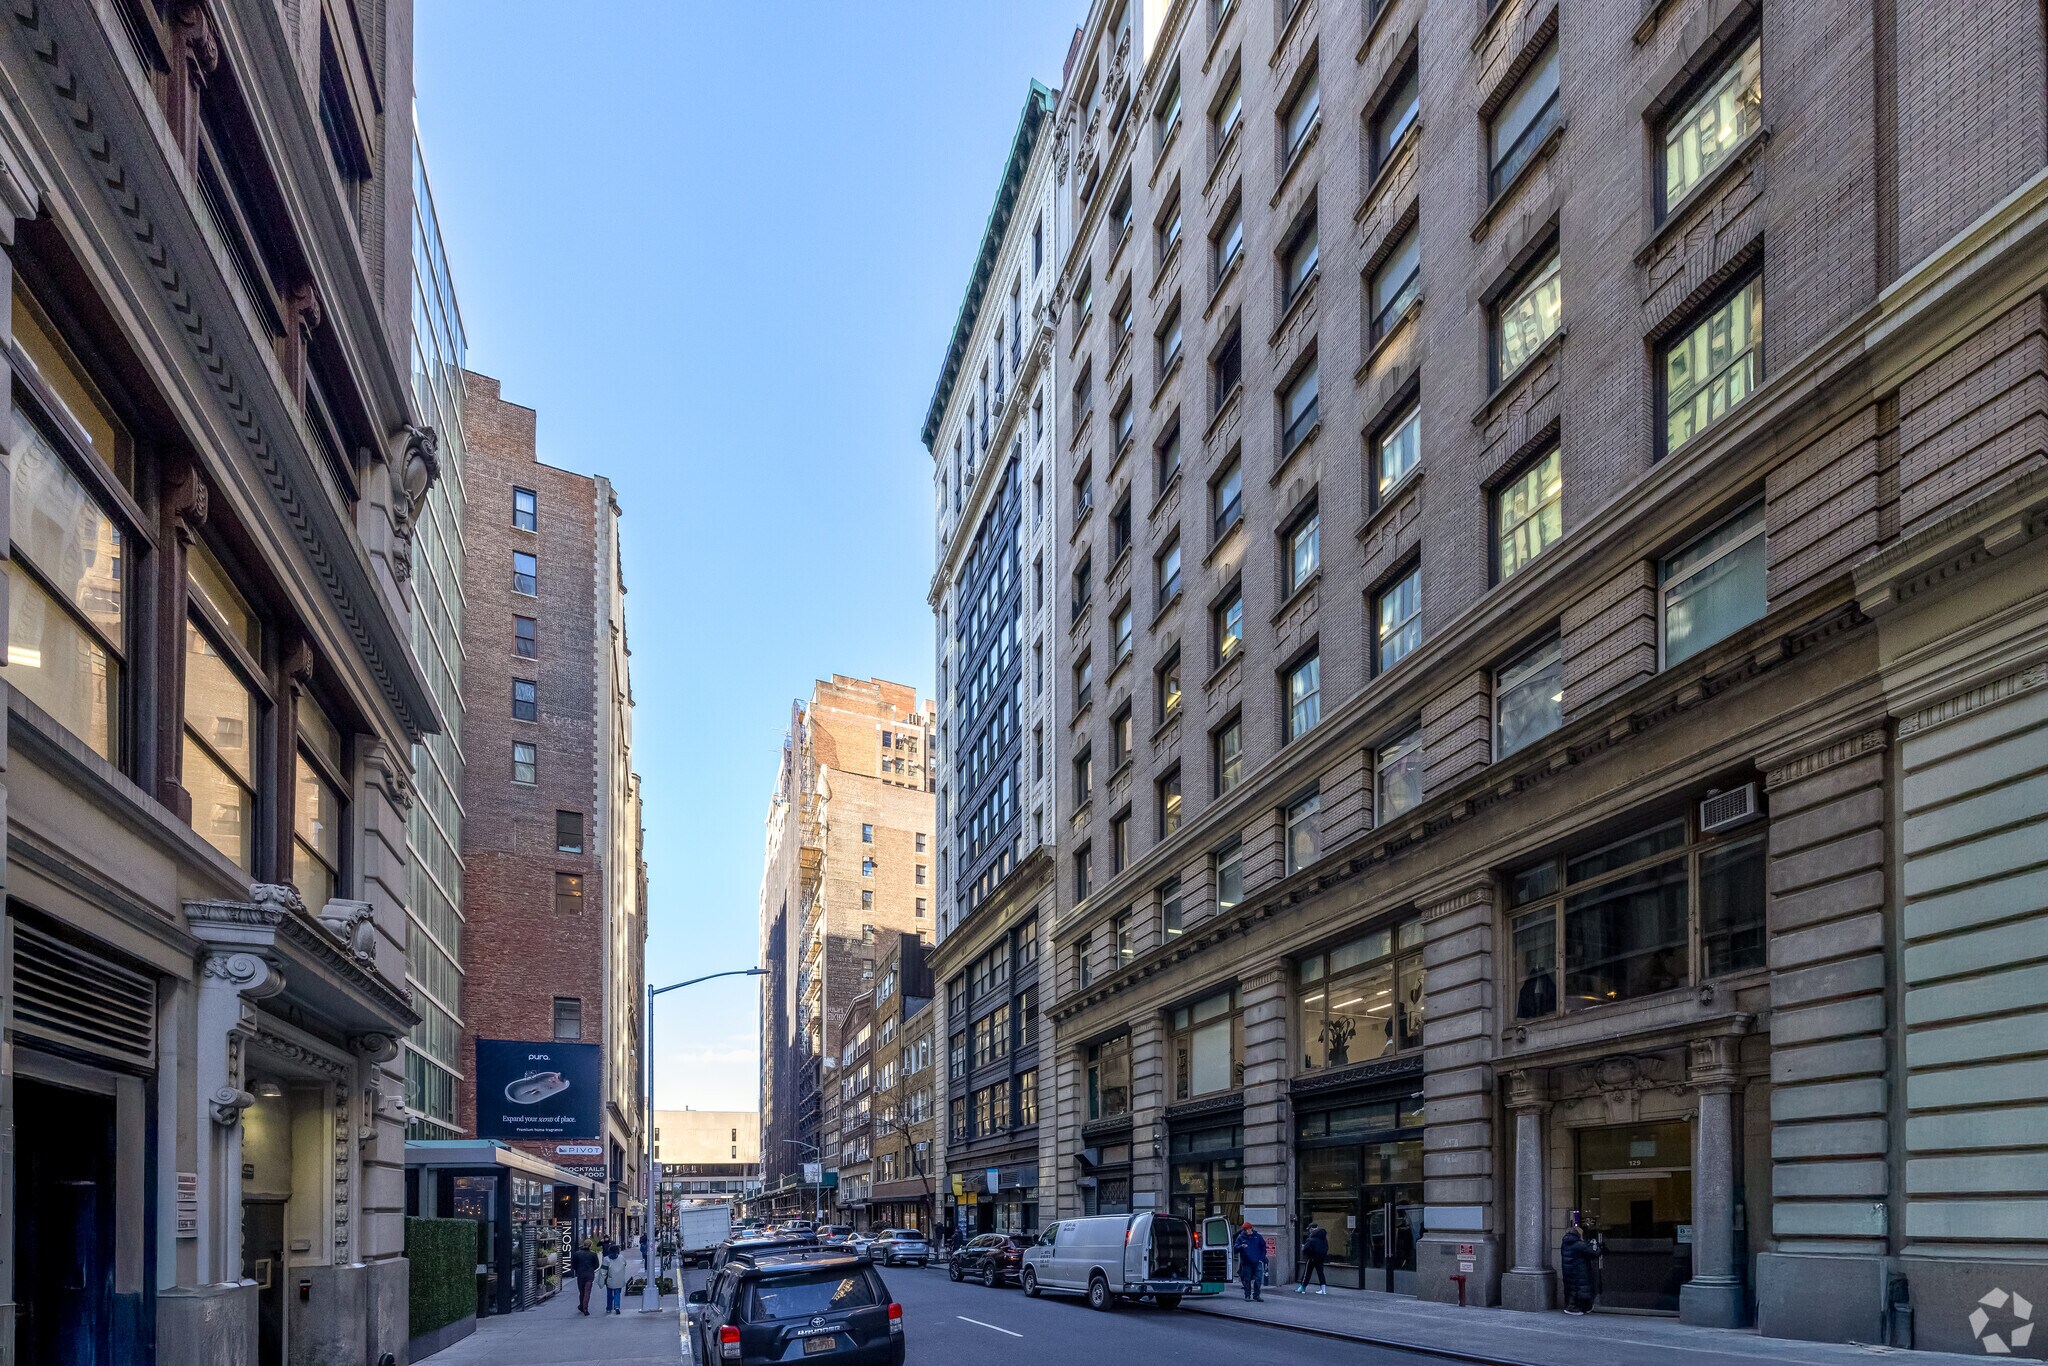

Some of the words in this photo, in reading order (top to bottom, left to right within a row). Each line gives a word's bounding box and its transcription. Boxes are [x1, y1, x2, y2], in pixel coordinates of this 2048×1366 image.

[502, 1115, 524, 1124] Expand
[524, 1116, 538, 1124] your
[562, 1226, 572, 1273] WILSON
